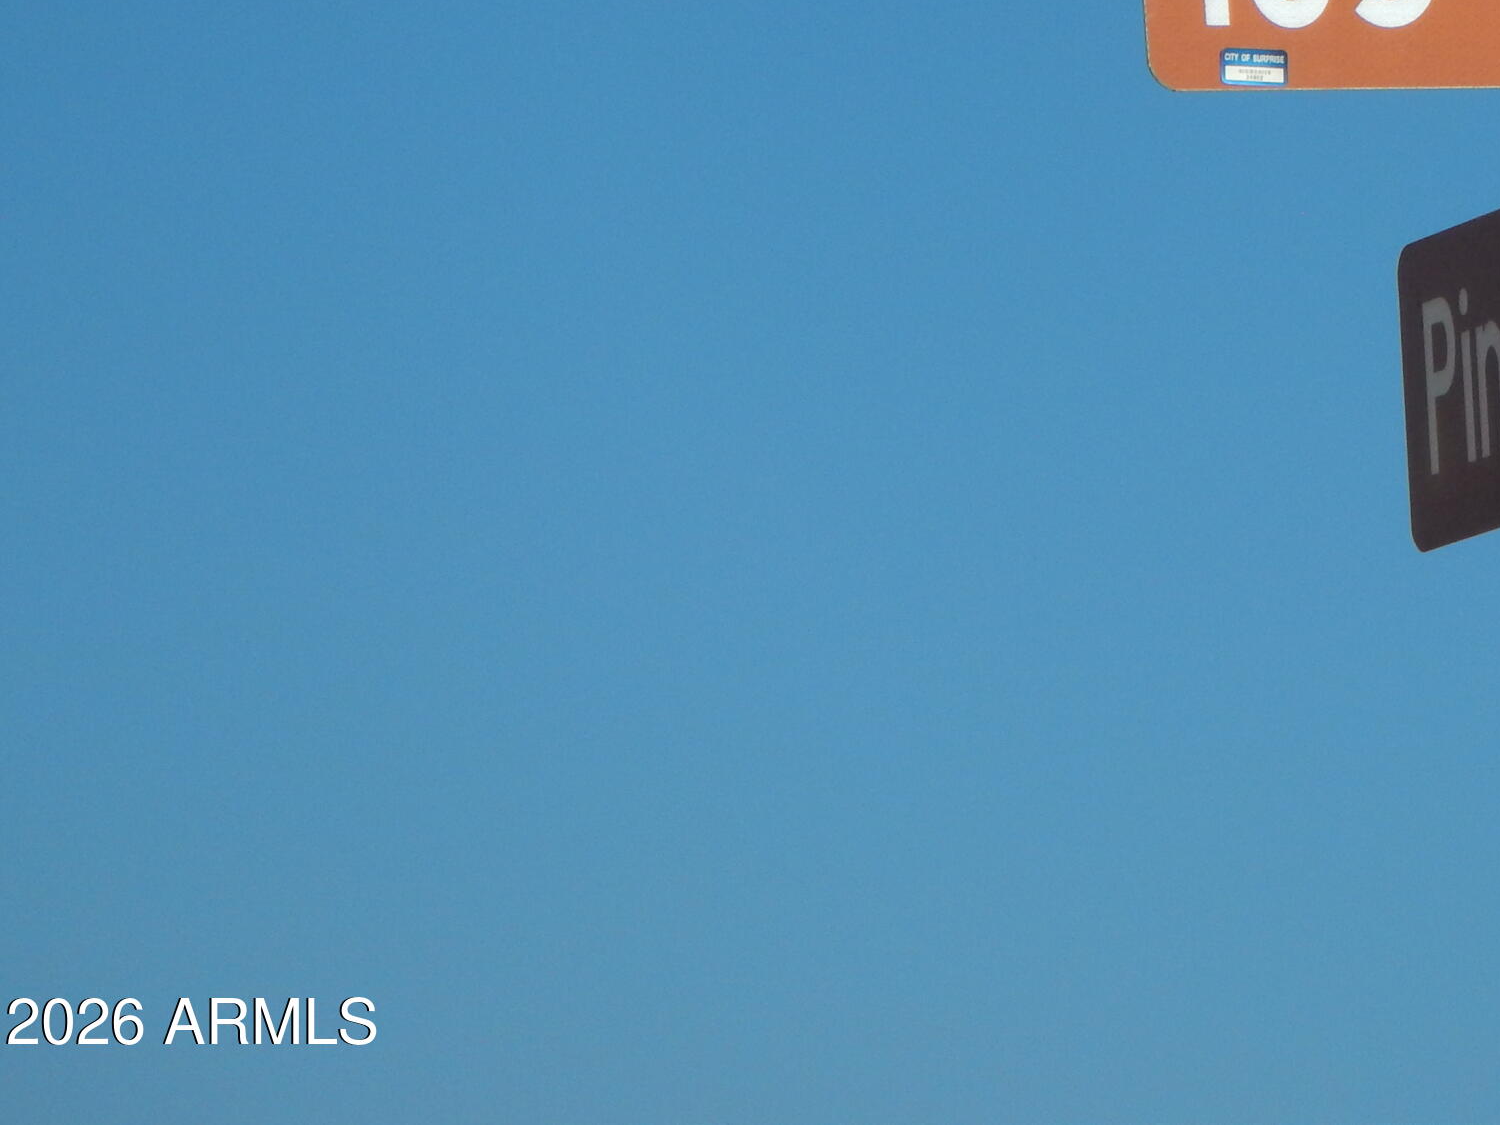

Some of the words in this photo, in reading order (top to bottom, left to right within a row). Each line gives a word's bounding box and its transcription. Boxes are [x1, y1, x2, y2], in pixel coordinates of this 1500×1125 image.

[1224, 52, 1239, 62] CITY
[1241, 53, 1251, 62] OF
[1253, 54, 1285, 64] SURPRISE
